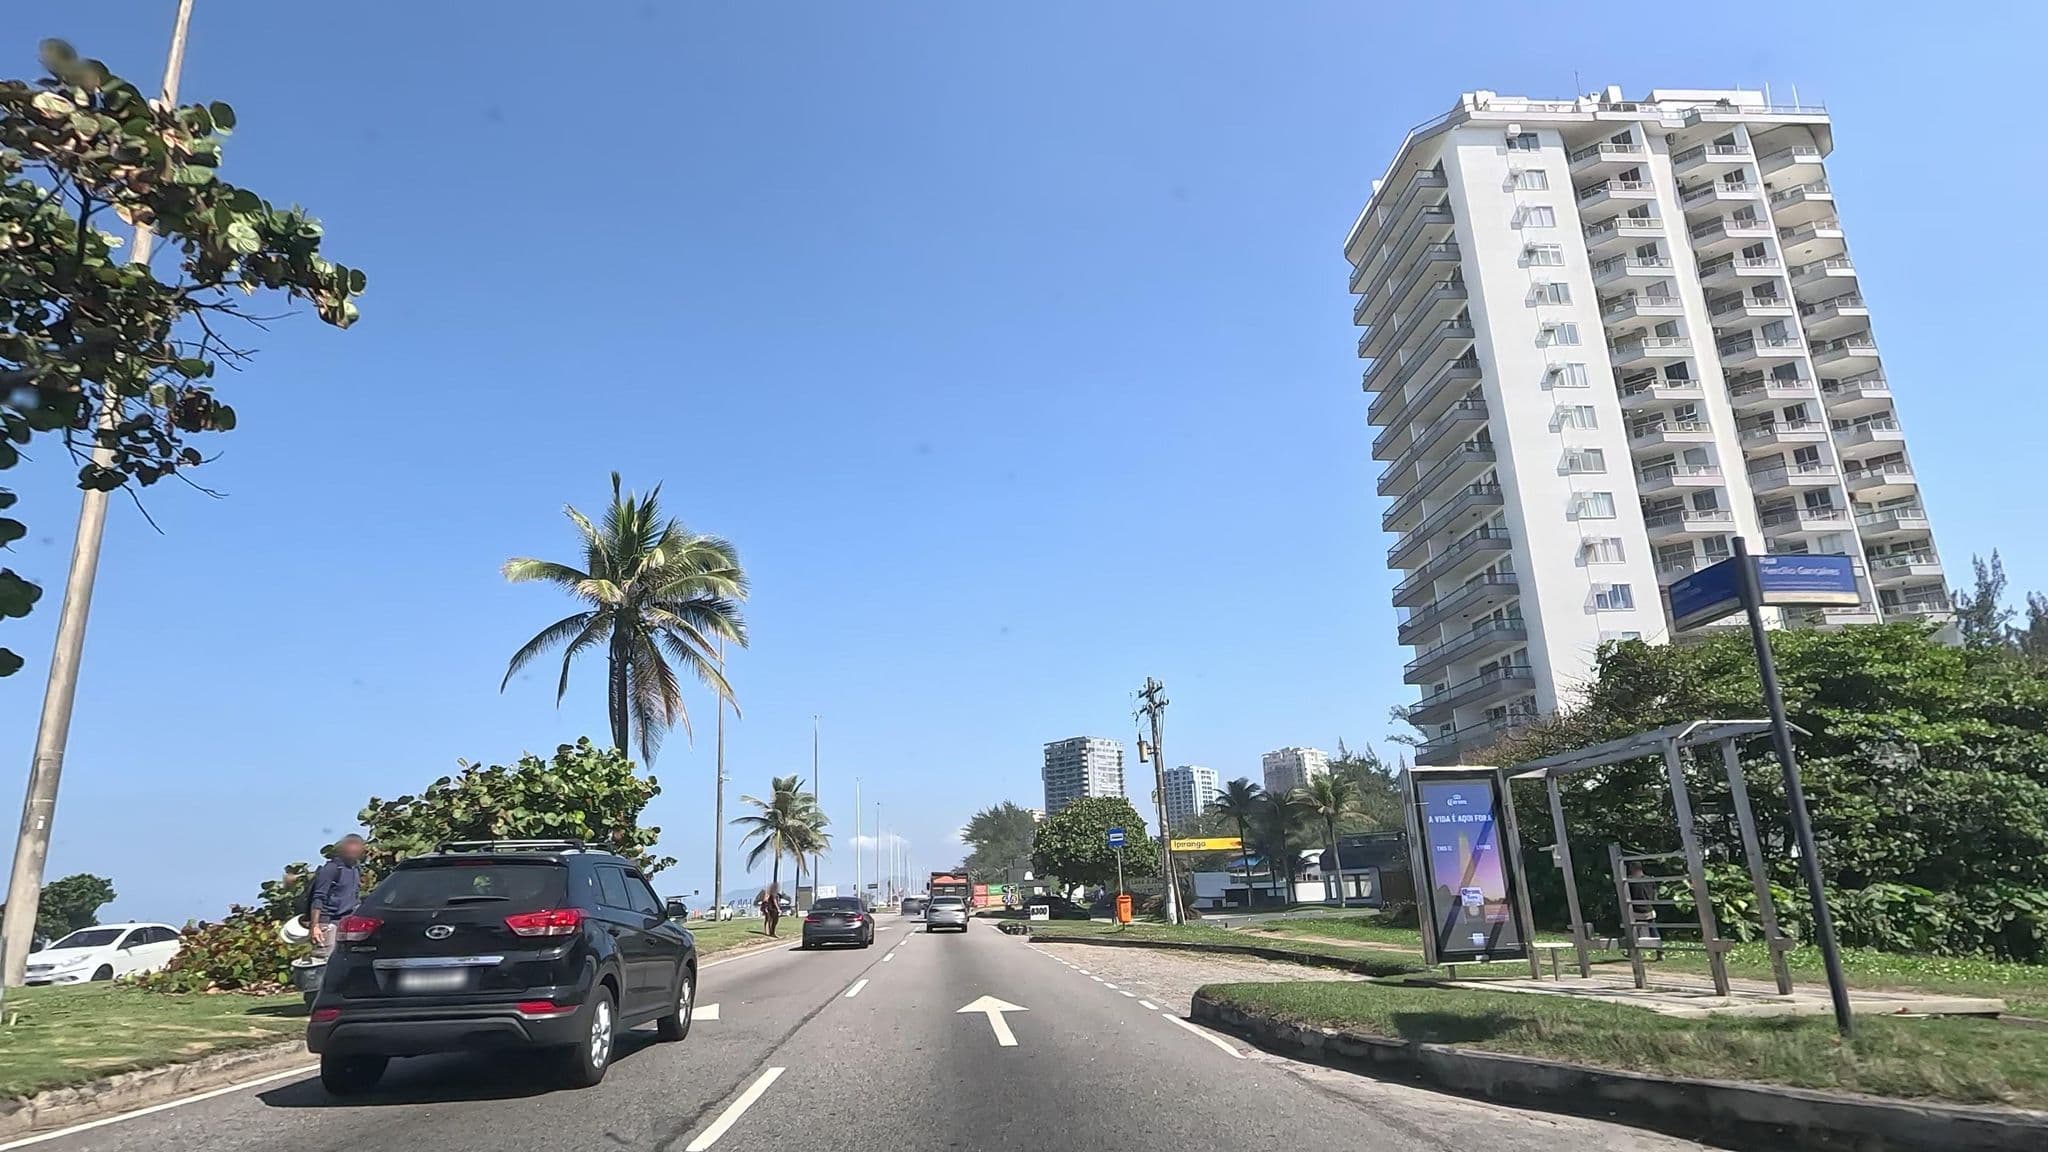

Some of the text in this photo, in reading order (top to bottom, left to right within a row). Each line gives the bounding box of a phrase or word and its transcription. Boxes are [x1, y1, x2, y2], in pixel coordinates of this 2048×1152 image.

[1428, 813, 1493, 823] A VIDA É AQUI FORA
